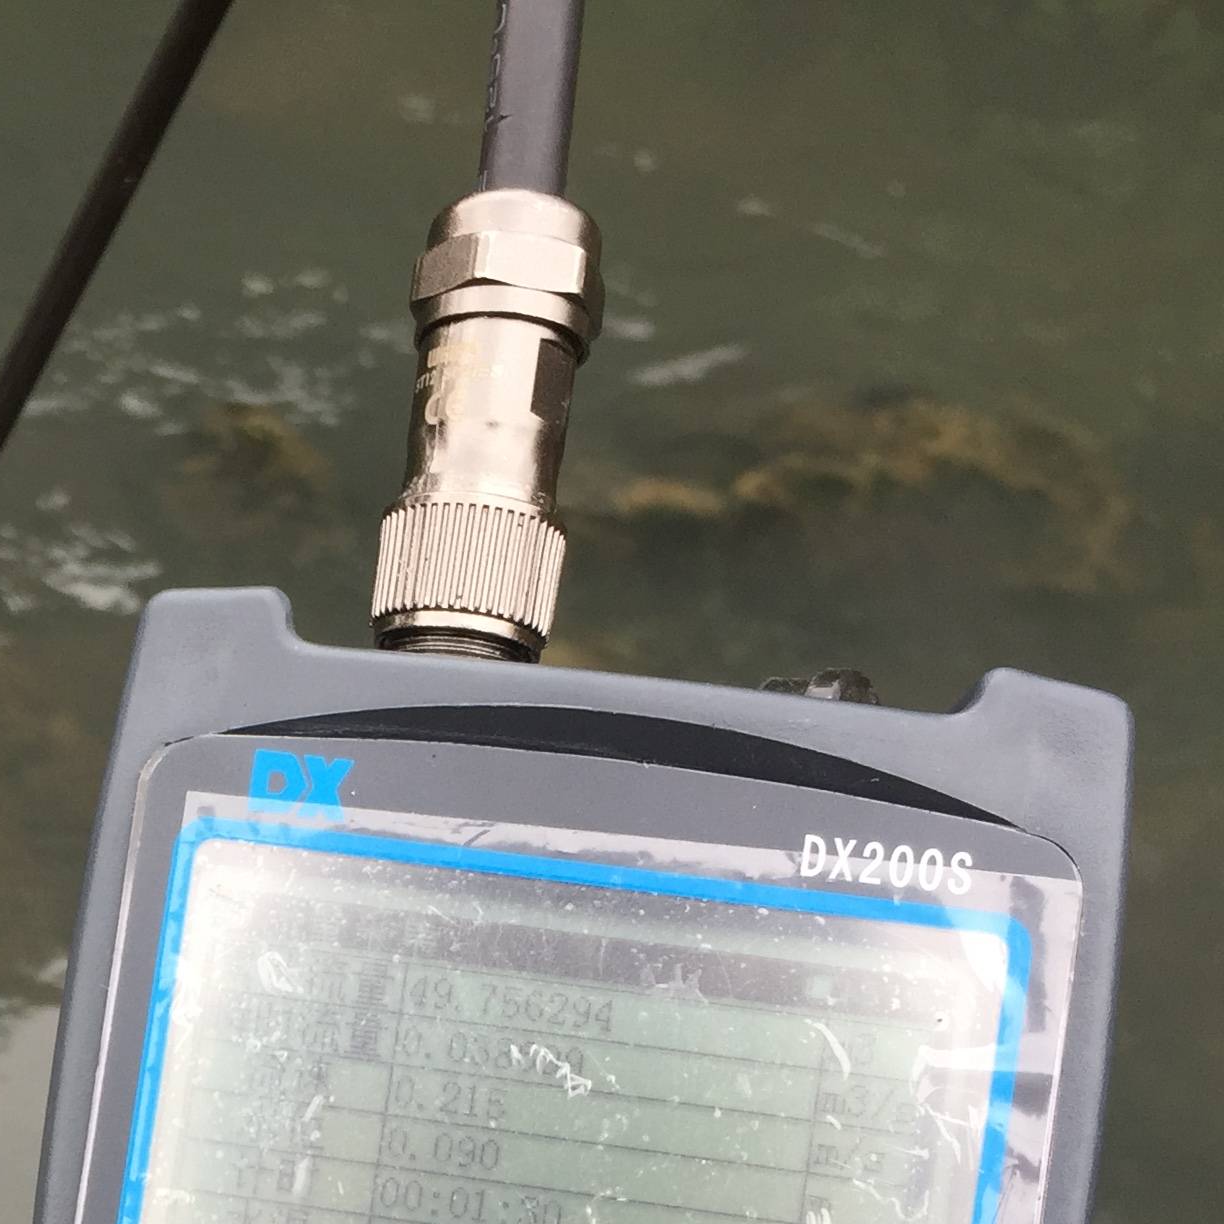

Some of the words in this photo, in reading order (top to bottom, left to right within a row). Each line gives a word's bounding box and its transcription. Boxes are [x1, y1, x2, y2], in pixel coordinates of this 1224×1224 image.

[248, 748, 355, 821] DX
[800, 834, 973, 896] DX200S
[388, 1127, 500, 1171] 0.090
